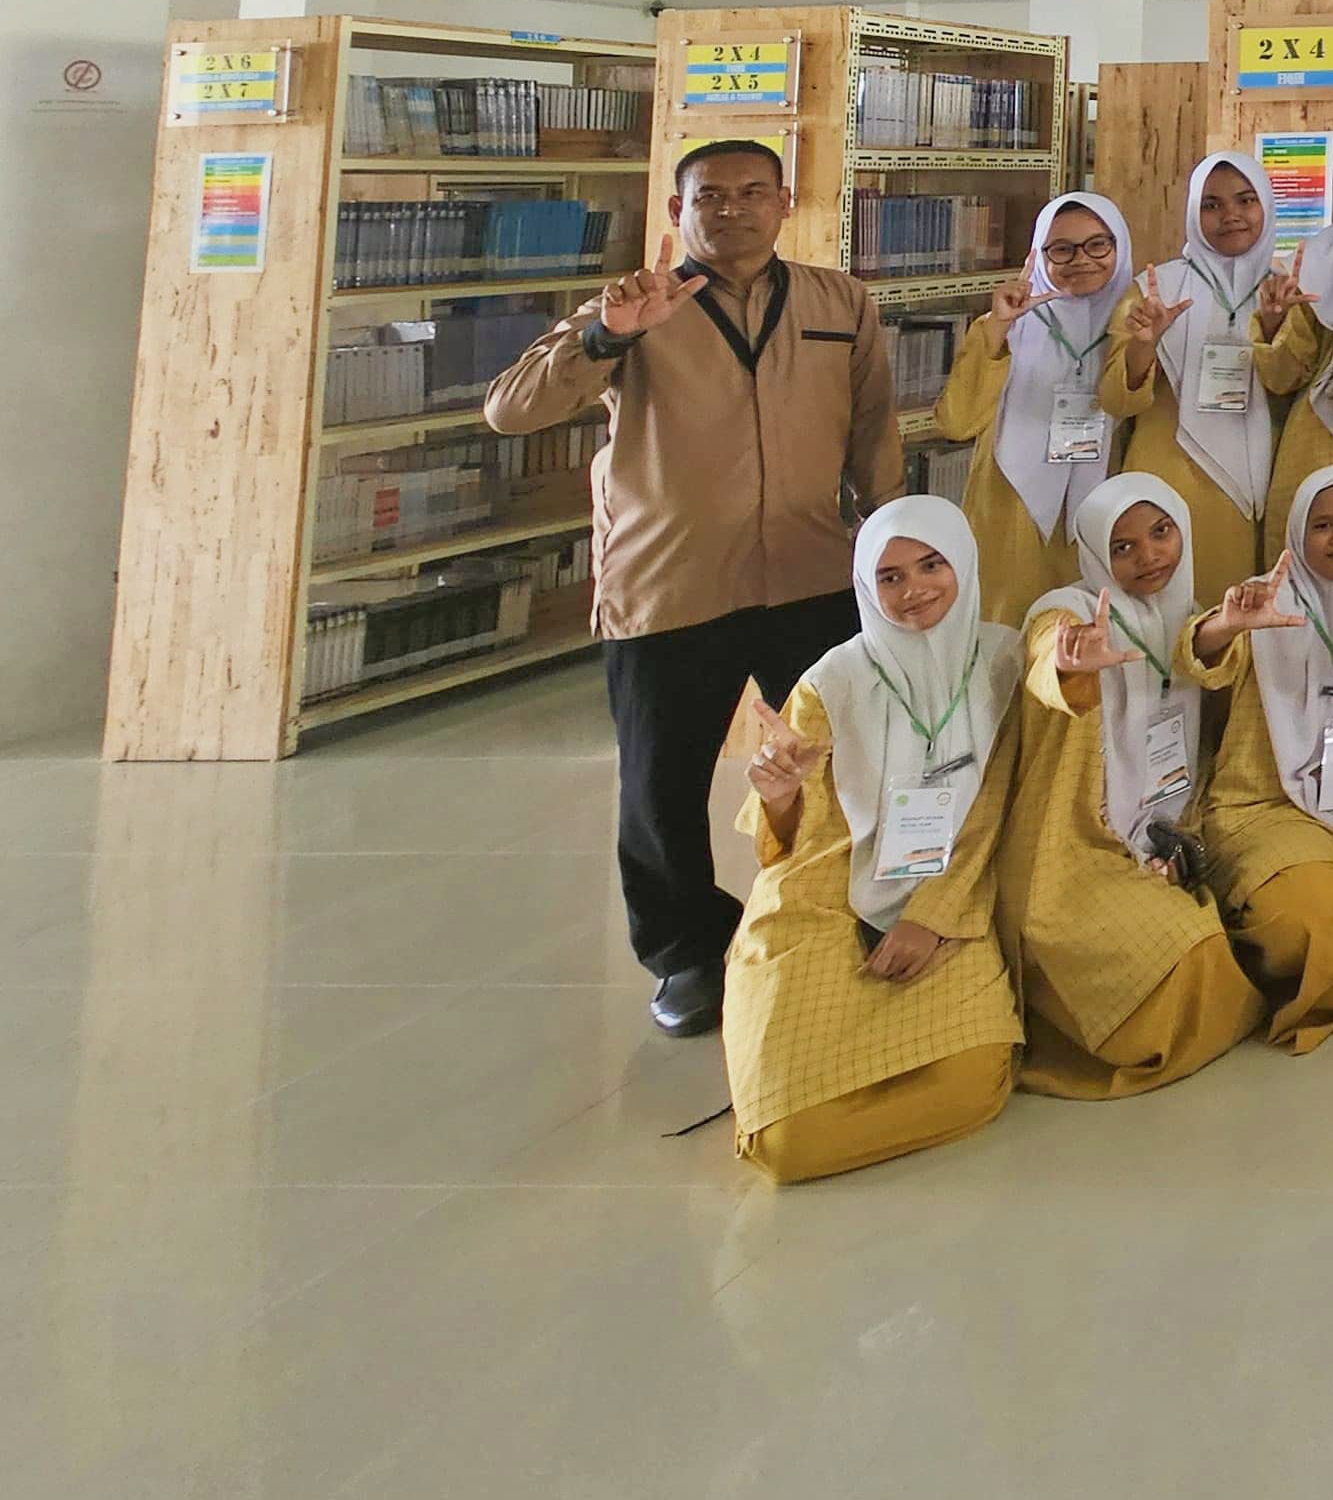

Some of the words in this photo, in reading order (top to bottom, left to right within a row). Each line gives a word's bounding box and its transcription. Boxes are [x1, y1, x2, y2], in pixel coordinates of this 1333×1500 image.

[713, 47, 723, 61] 2
[730, 46, 743, 61] X
[749, 46, 760, 60] 4
[1258, 39, 1274, 60] 2
[1282, 38, 1300, 59] X
[1309, 37, 1326, 58] 4
[206, 56, 216, 71] 2
[222, 55, 235, 70] X
[240, 54, 251, 69] 6
[712, 75, 722, 90] 2
[729, 74, 742, 90] X
[748, 74, 759, 90] 5
[203, 83, 213, 99] 2
[221, 83, 232, 98] X
[240, 83, 249, 97] 7
